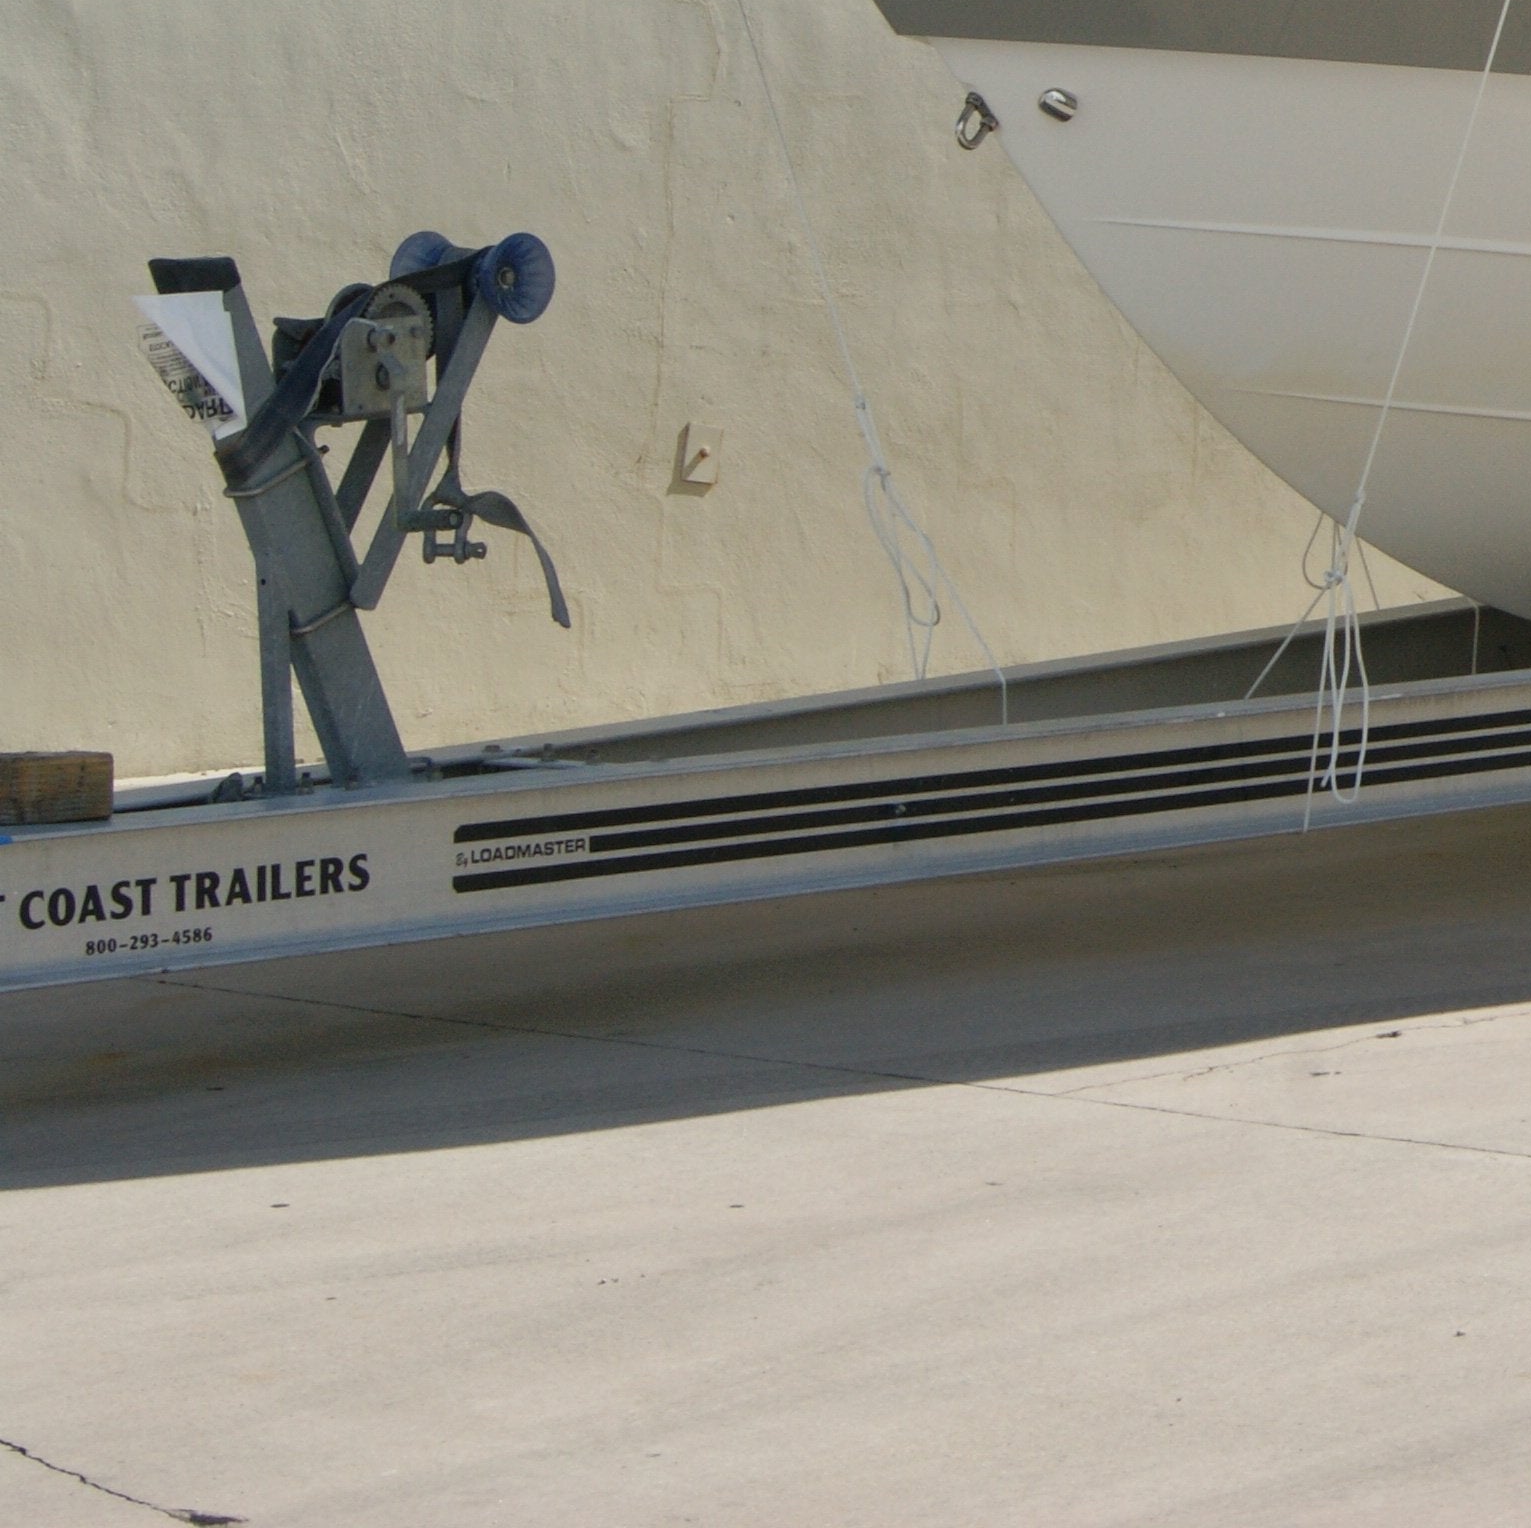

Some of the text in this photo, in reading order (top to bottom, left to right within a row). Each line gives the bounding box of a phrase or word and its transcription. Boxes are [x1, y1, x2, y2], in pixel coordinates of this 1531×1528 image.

[471, 838, 586, 864] LOADMASTER
[19, 853, 371, 930] COAST TRAILERS
[85, 926, 213, 956] 800-293-4586
